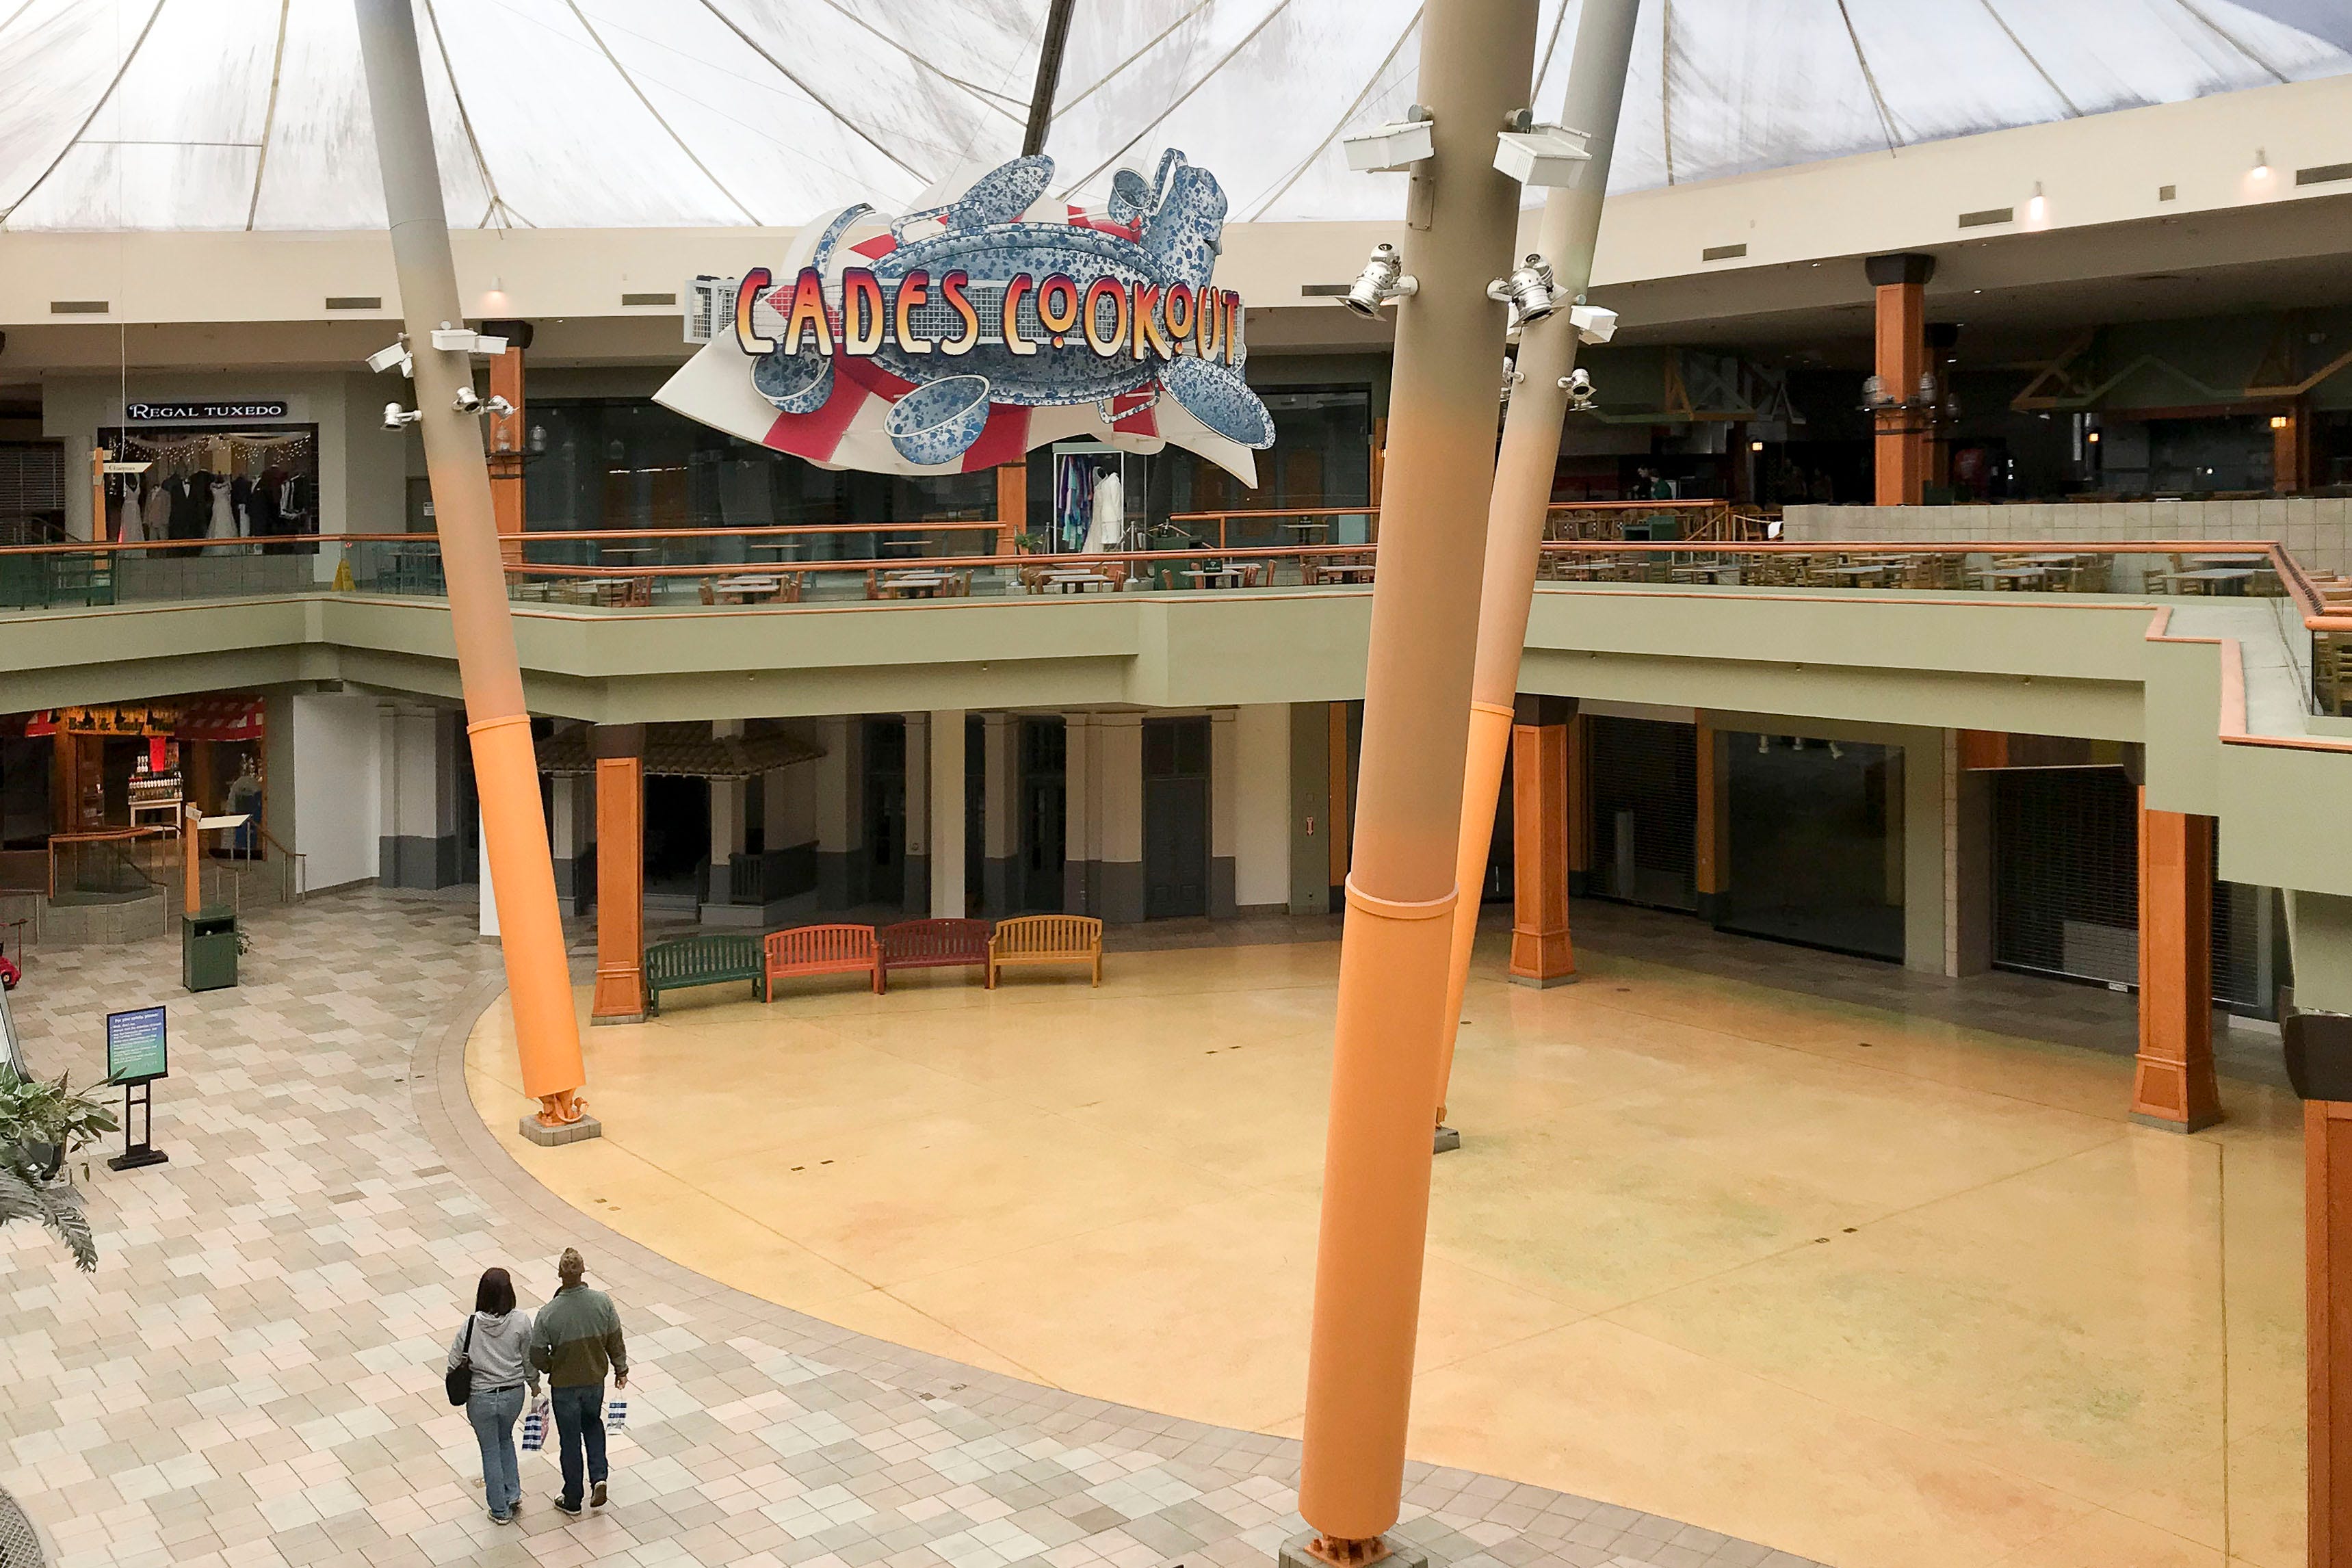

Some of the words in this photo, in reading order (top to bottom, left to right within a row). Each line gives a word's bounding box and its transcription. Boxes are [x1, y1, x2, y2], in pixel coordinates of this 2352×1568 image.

[734, 267, 980, 356] CADES
[1002, 272, 1240, 365] COOKOUT
[129, 404, 199, 419] REGAL
[204, 406, 282, 417] TUXEDO
